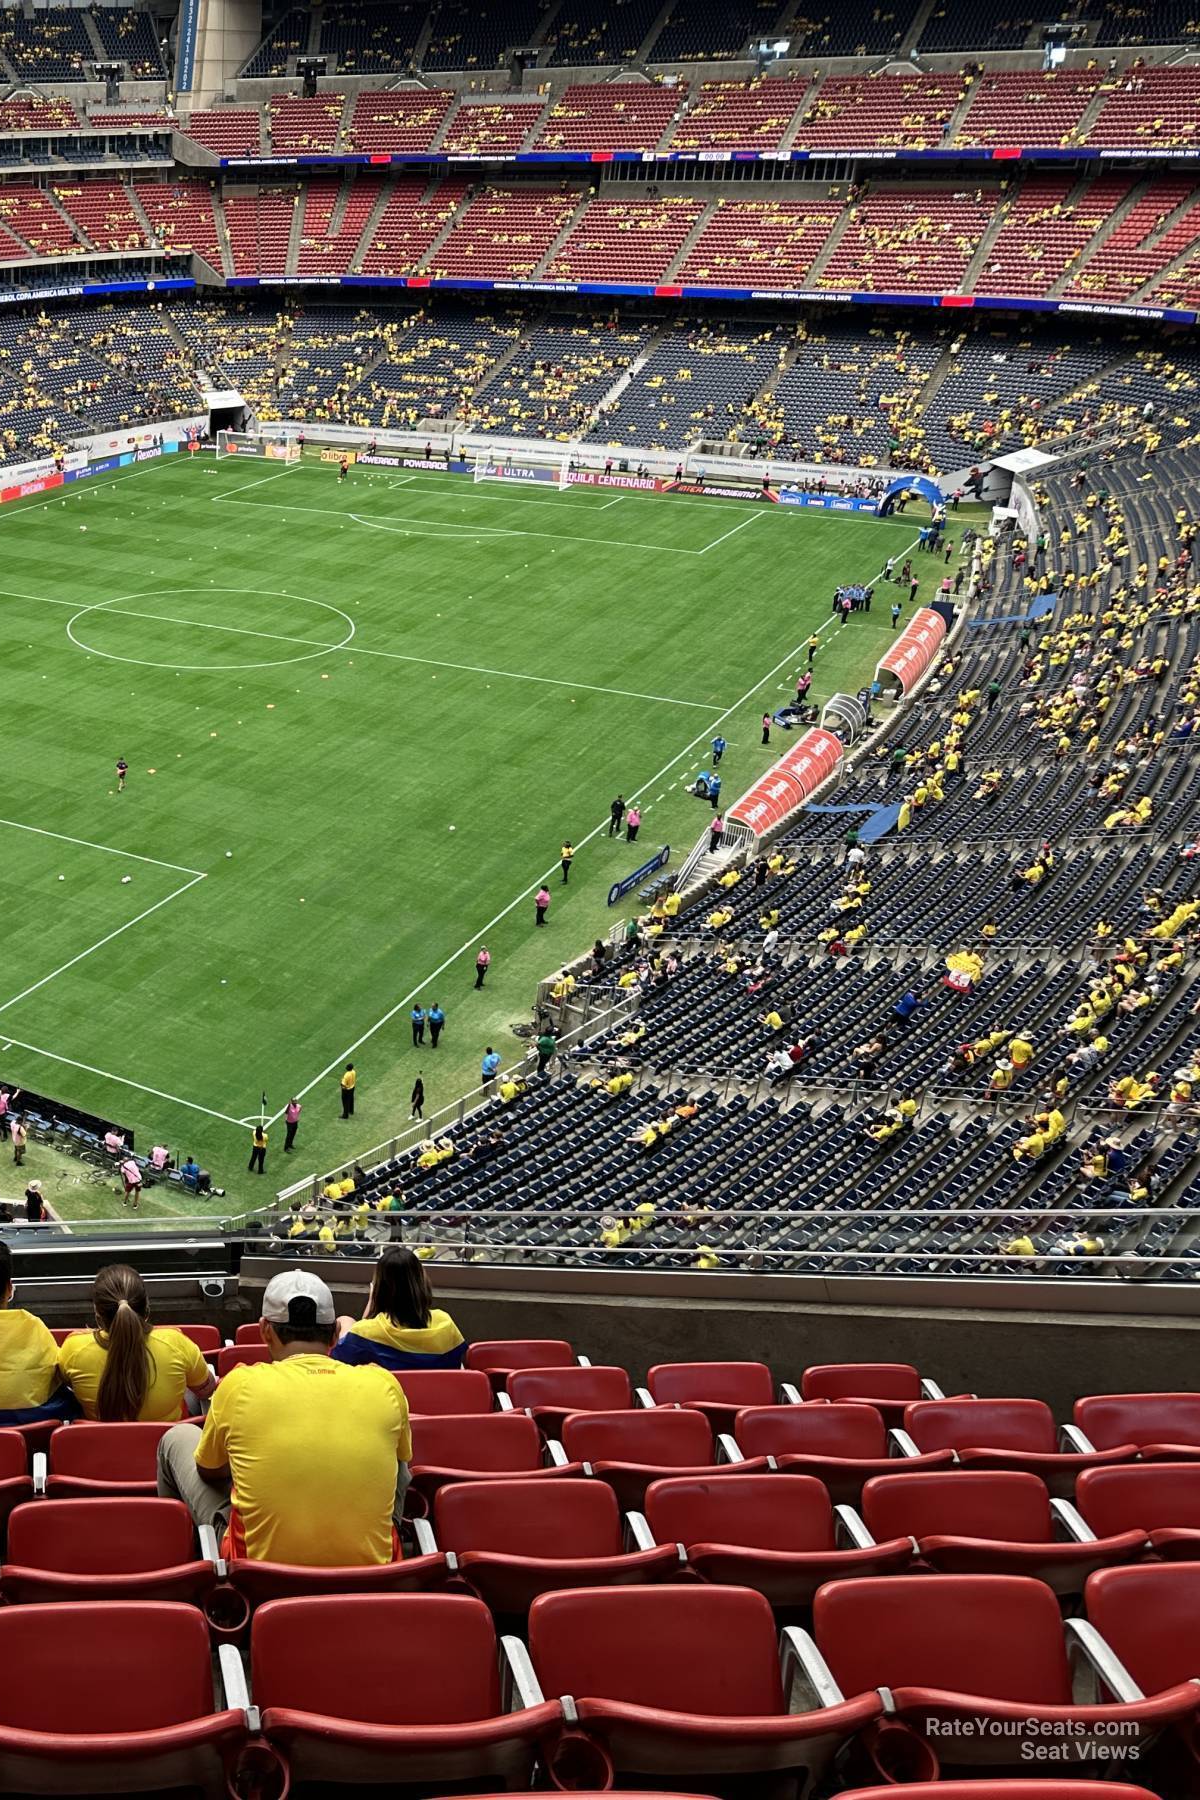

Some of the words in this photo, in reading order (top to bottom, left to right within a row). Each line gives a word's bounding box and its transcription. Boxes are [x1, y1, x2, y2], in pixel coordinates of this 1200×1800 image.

[137, 447, 162, 462] Rexona
[356, 454, 399, 466] POWERADE
[403, 459, 448, 471] POWERADE
[504, 468, 535, 478] ULTRA
[598, 475, 656, 490] CENTENARIO
